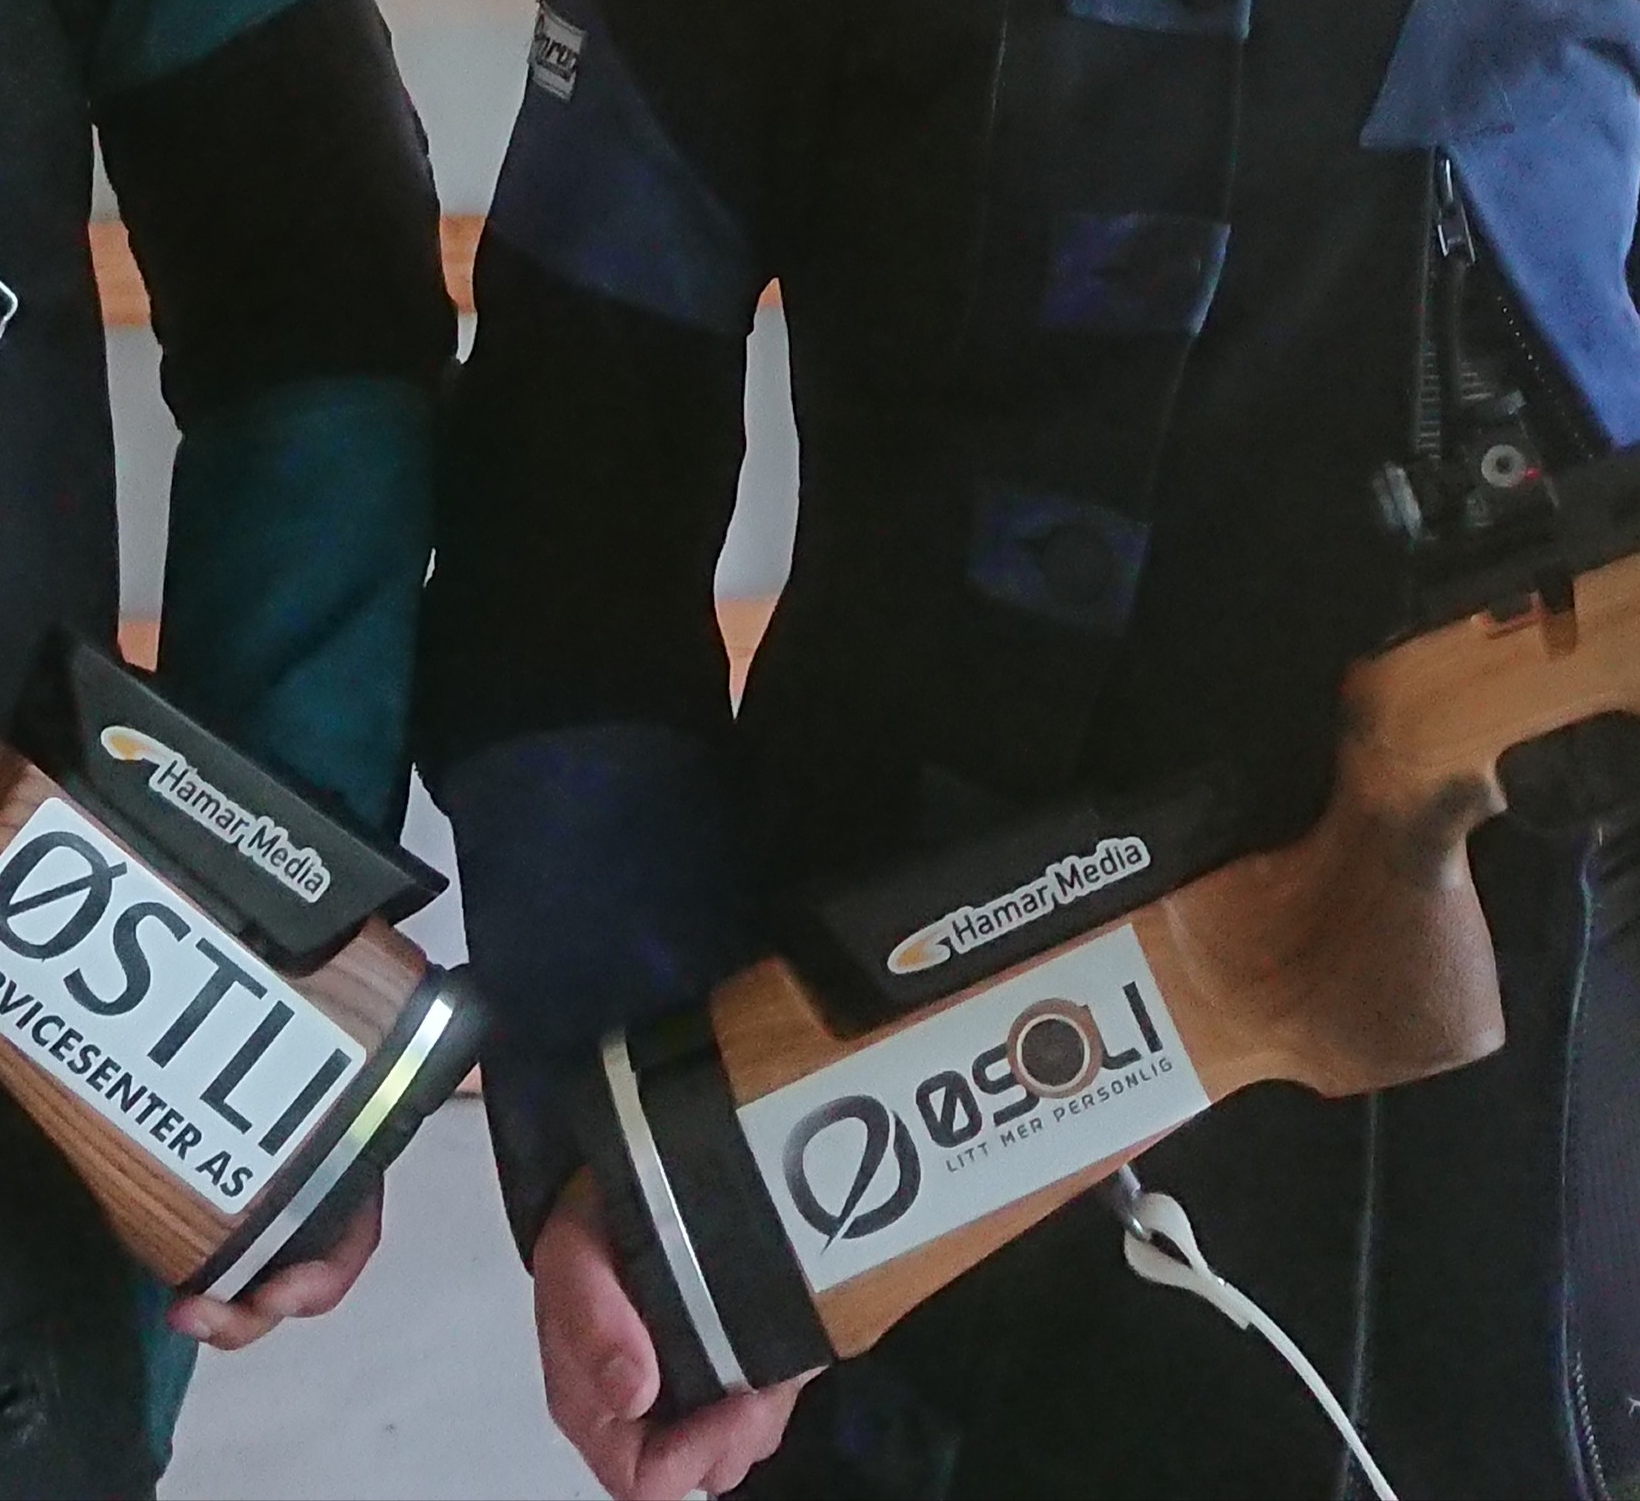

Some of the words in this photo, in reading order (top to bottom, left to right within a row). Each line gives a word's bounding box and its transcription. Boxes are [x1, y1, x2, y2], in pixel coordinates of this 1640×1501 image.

[159, 758, 254, 842] Hamar
[254, 821, 326, 898] Media
[952, 886, 1051, 947] Hamar
[1054, 839, 1145, 898] Media
[945, 1141, 990, 1173] LITT
[999, 1116, 1044, 1148] MER
[1052, 1056, 1174, 1124] PERSONLIG
[196, 1148, 255, 1199] AS
